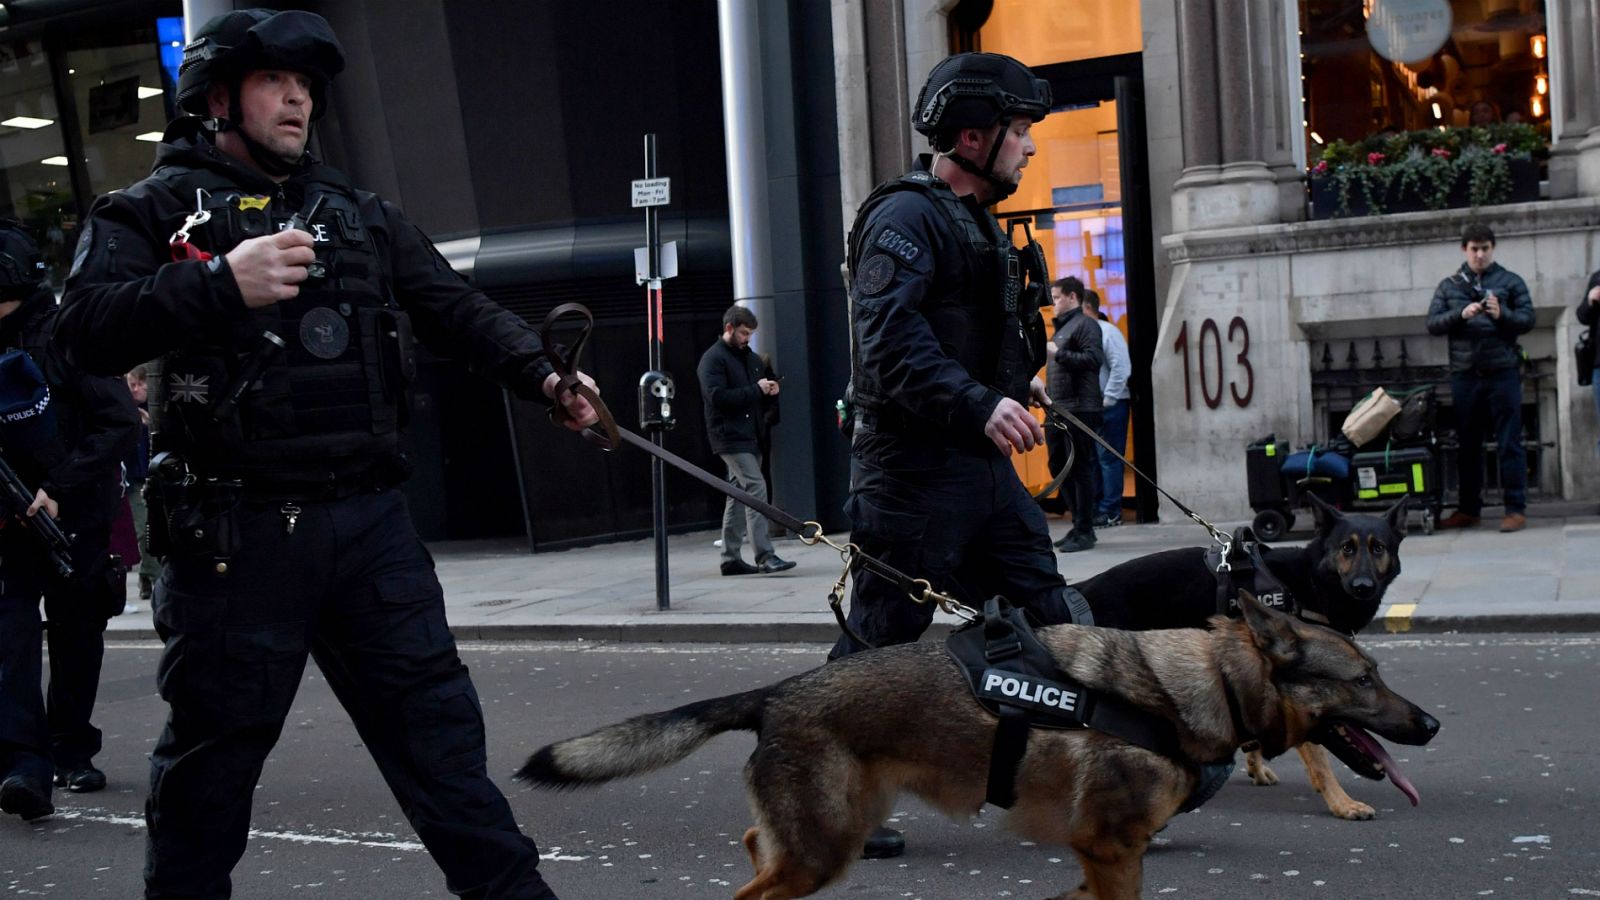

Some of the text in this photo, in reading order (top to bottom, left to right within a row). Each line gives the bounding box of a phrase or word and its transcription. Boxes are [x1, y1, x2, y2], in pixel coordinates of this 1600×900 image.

[1174, 316, 1254, 410] 103
[6, 408, 36, 422] POLICE
[1229, 593, 1284, 610] PICE
[984, 674, 1078, 711] POLICE
